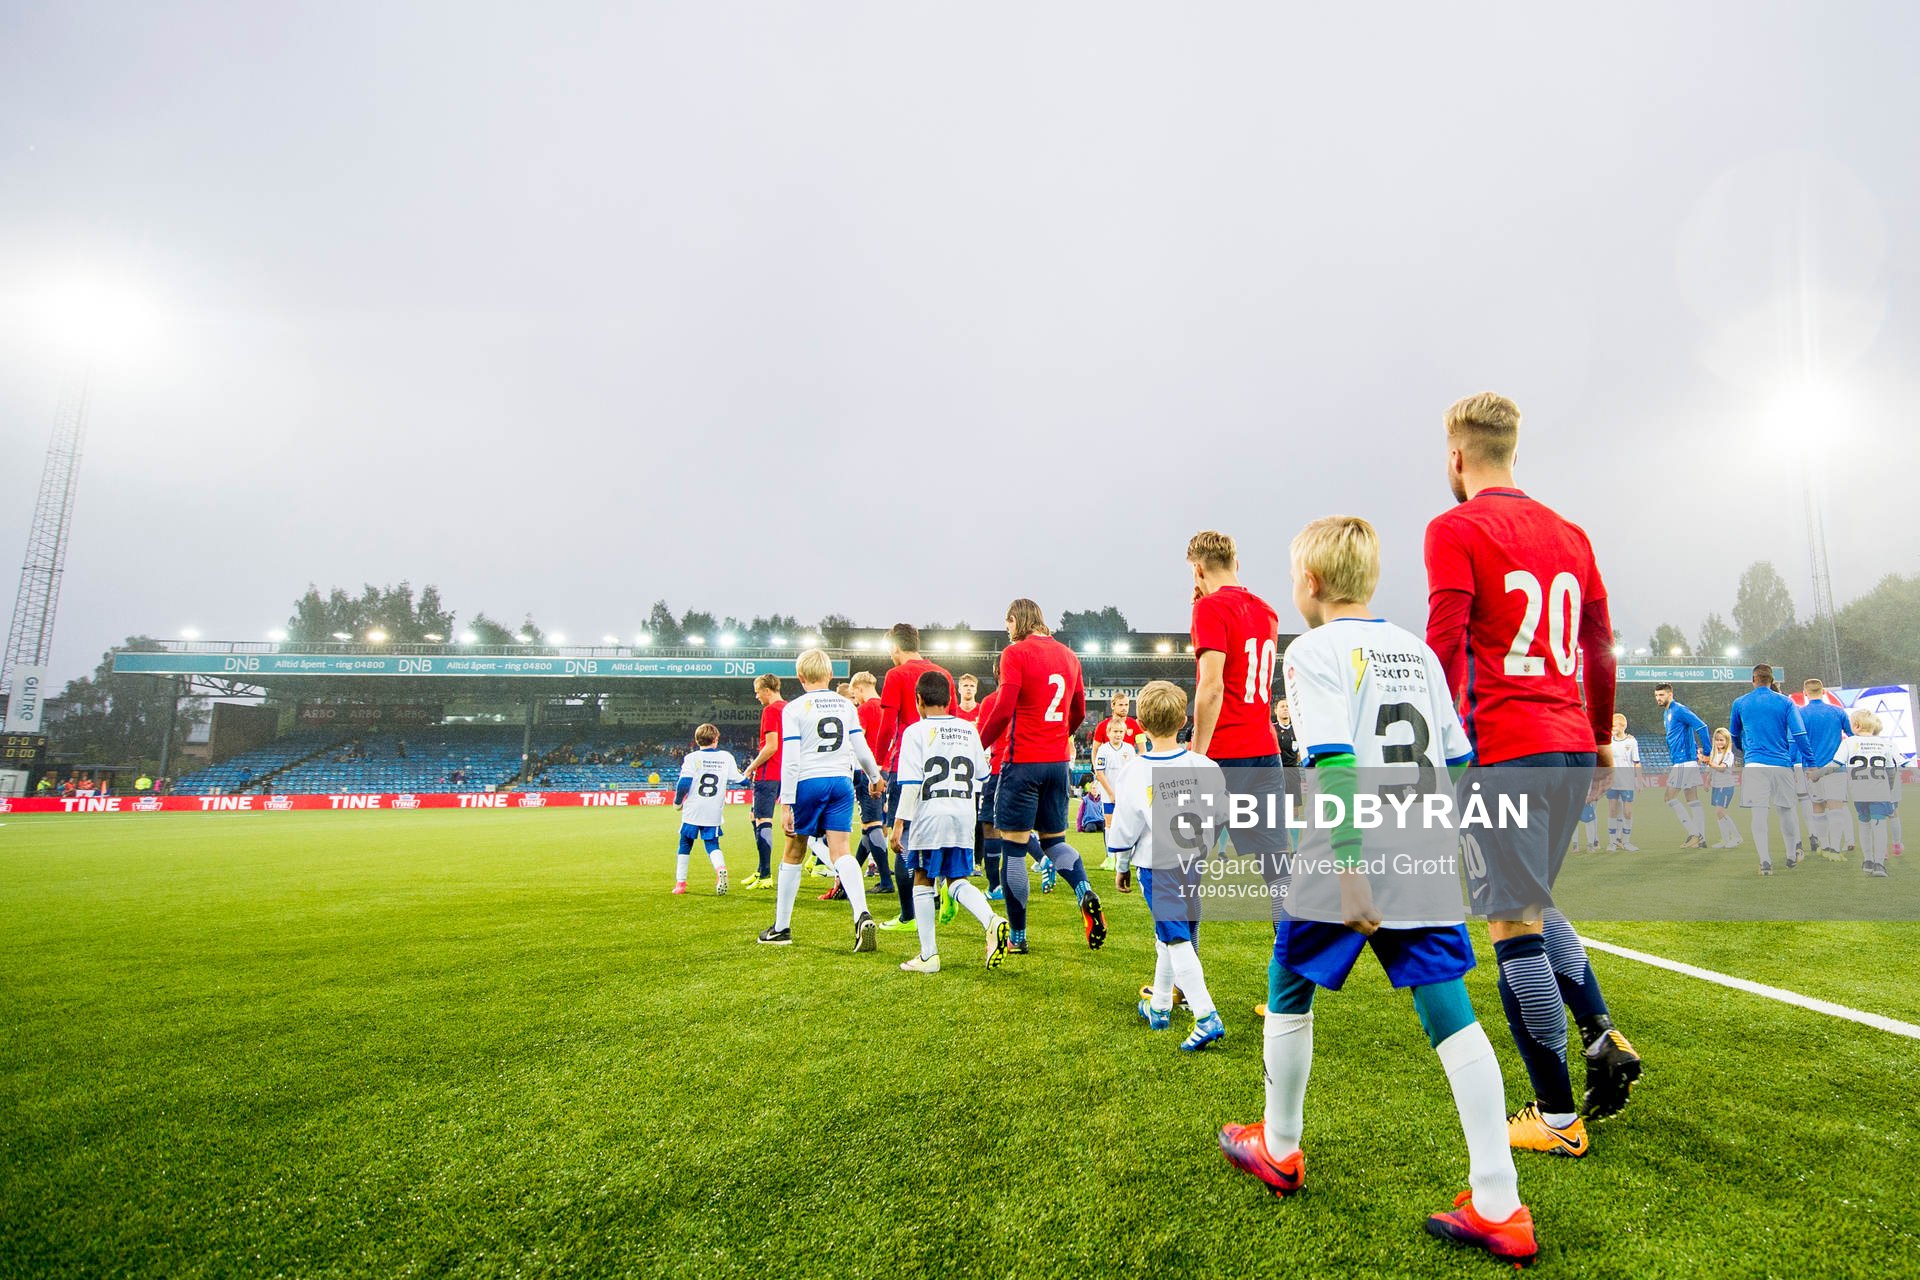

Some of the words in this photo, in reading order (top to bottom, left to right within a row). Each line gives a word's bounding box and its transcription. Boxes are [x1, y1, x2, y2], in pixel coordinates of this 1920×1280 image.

[1503, 569, 1581, 676] 20
[224, 656, 260, 673] DNB
[274, 660, 298, 669] Alltid
[300, 659, 327, 670] åpent
[335, 661, 353, 671] ring
[354, 660, 385, 669] 04800
[398, 657, 432, 674] DNB
[446, 661, 469, 670] Alltid
[470, 661, 497, 671] åpent
[505, 662, 521, 672] ring
[522, 662, 552, 670] 04800
[565, 658, 598, 675] DNB
[611, 663, 633, 671] Alltid
[634, 662, 658, 673] åpent
[667, 663, 683, 673] ring
[684, 663, 712, 672] 04800
[724, 659, 755, 677] DNB
[1244, 637, 1276, 703] 10
[1712, 667, 1735, 681] DNB
[1044, 673, 1066, 722] 2
[817, 716, 844, 752] 9
[1375, 702, 1437, 804] 3
[1849, 756, 1886, 780] 28
[698, 773, 719, 797] 8
[922, 755, 974, 801] 23
[60, 798, 121, 812] TINE
[198, 796, 253, 810] TINE
[329, 795, 381, 809] TINE
[457, 794, 508, 807] TINE
[580, 793, 629, 806] TINE
